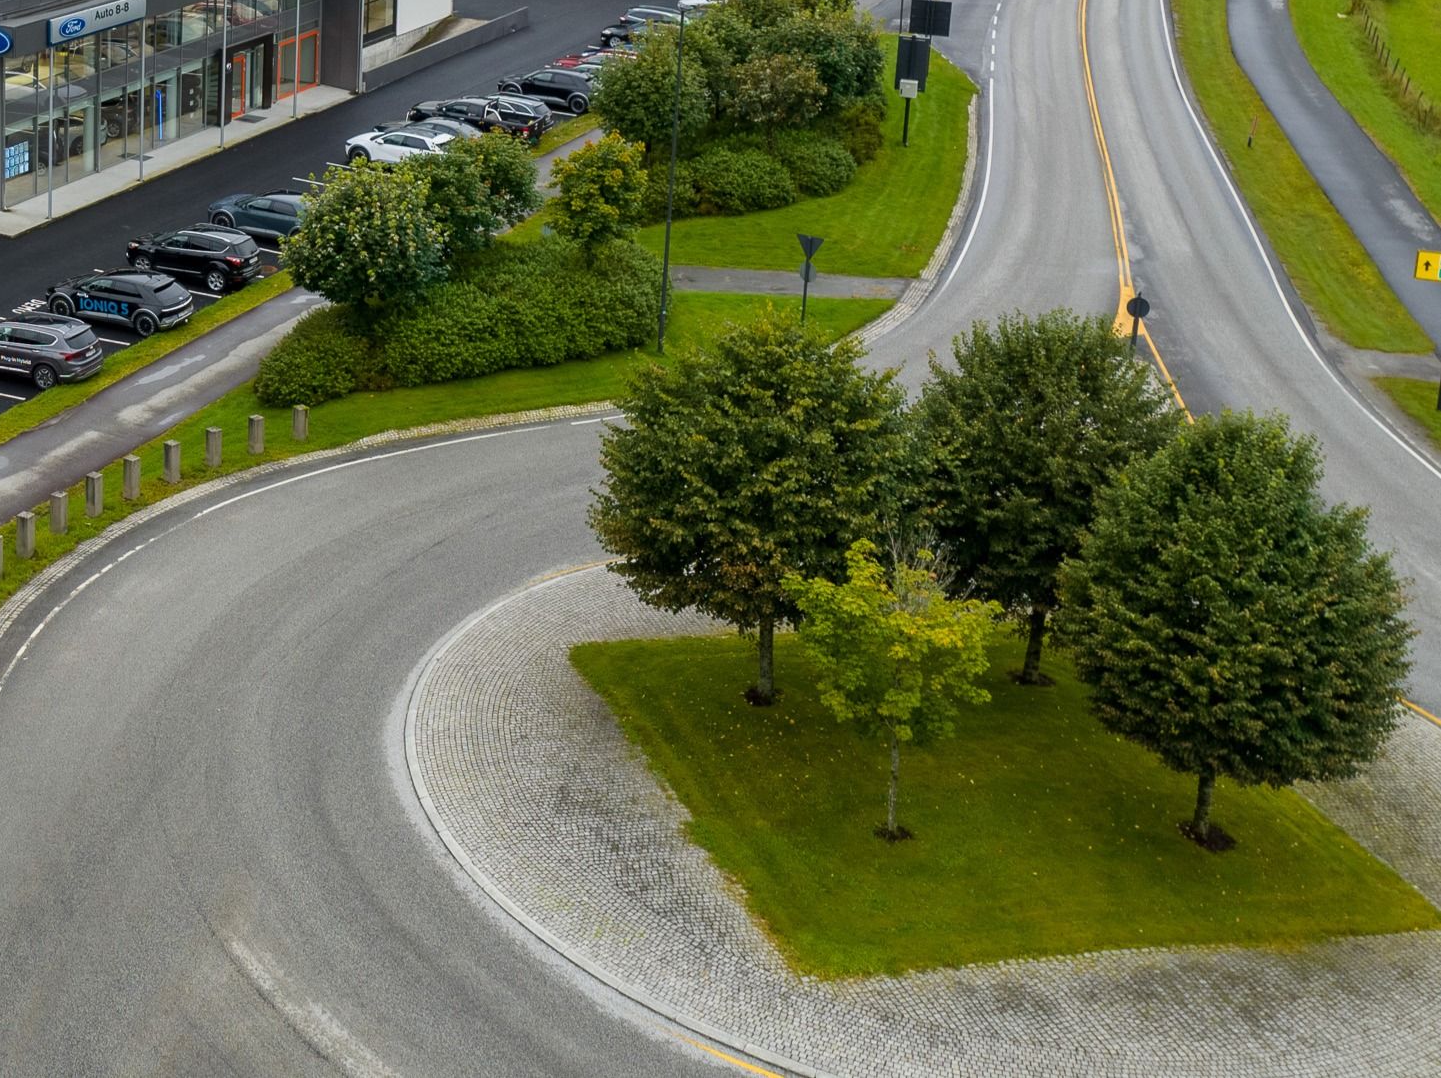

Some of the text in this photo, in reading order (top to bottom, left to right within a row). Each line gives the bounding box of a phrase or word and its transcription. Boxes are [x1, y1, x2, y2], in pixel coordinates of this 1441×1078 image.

[94, 2, 130, 21] Auto 8-8
[65, 20, 82, 34] Ford
[12, 298, 48, 314] DEMO
[80, 297, 129, 315] IONIQ 5
